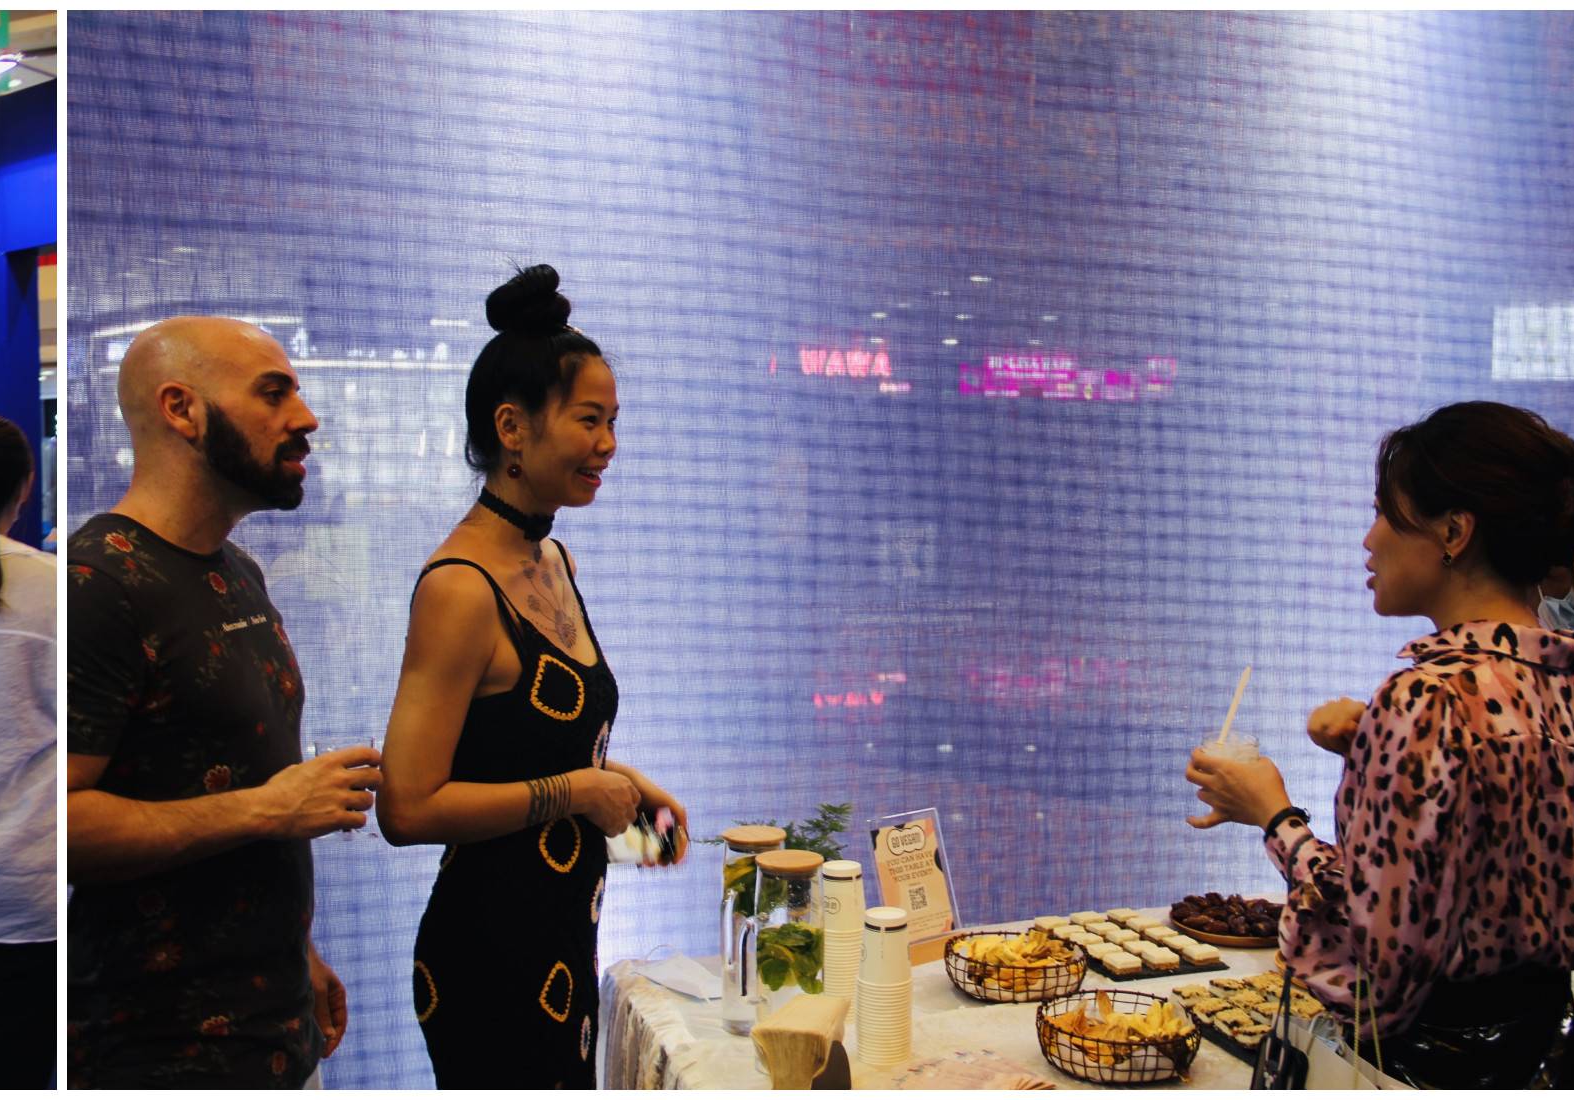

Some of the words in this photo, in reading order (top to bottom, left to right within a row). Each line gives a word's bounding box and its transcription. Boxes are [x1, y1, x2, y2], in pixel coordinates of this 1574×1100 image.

[800, 348, 892, 378] WAWA
[901, 854, 915, 863] CAN
[904, 861, 923, 871] TABLE
